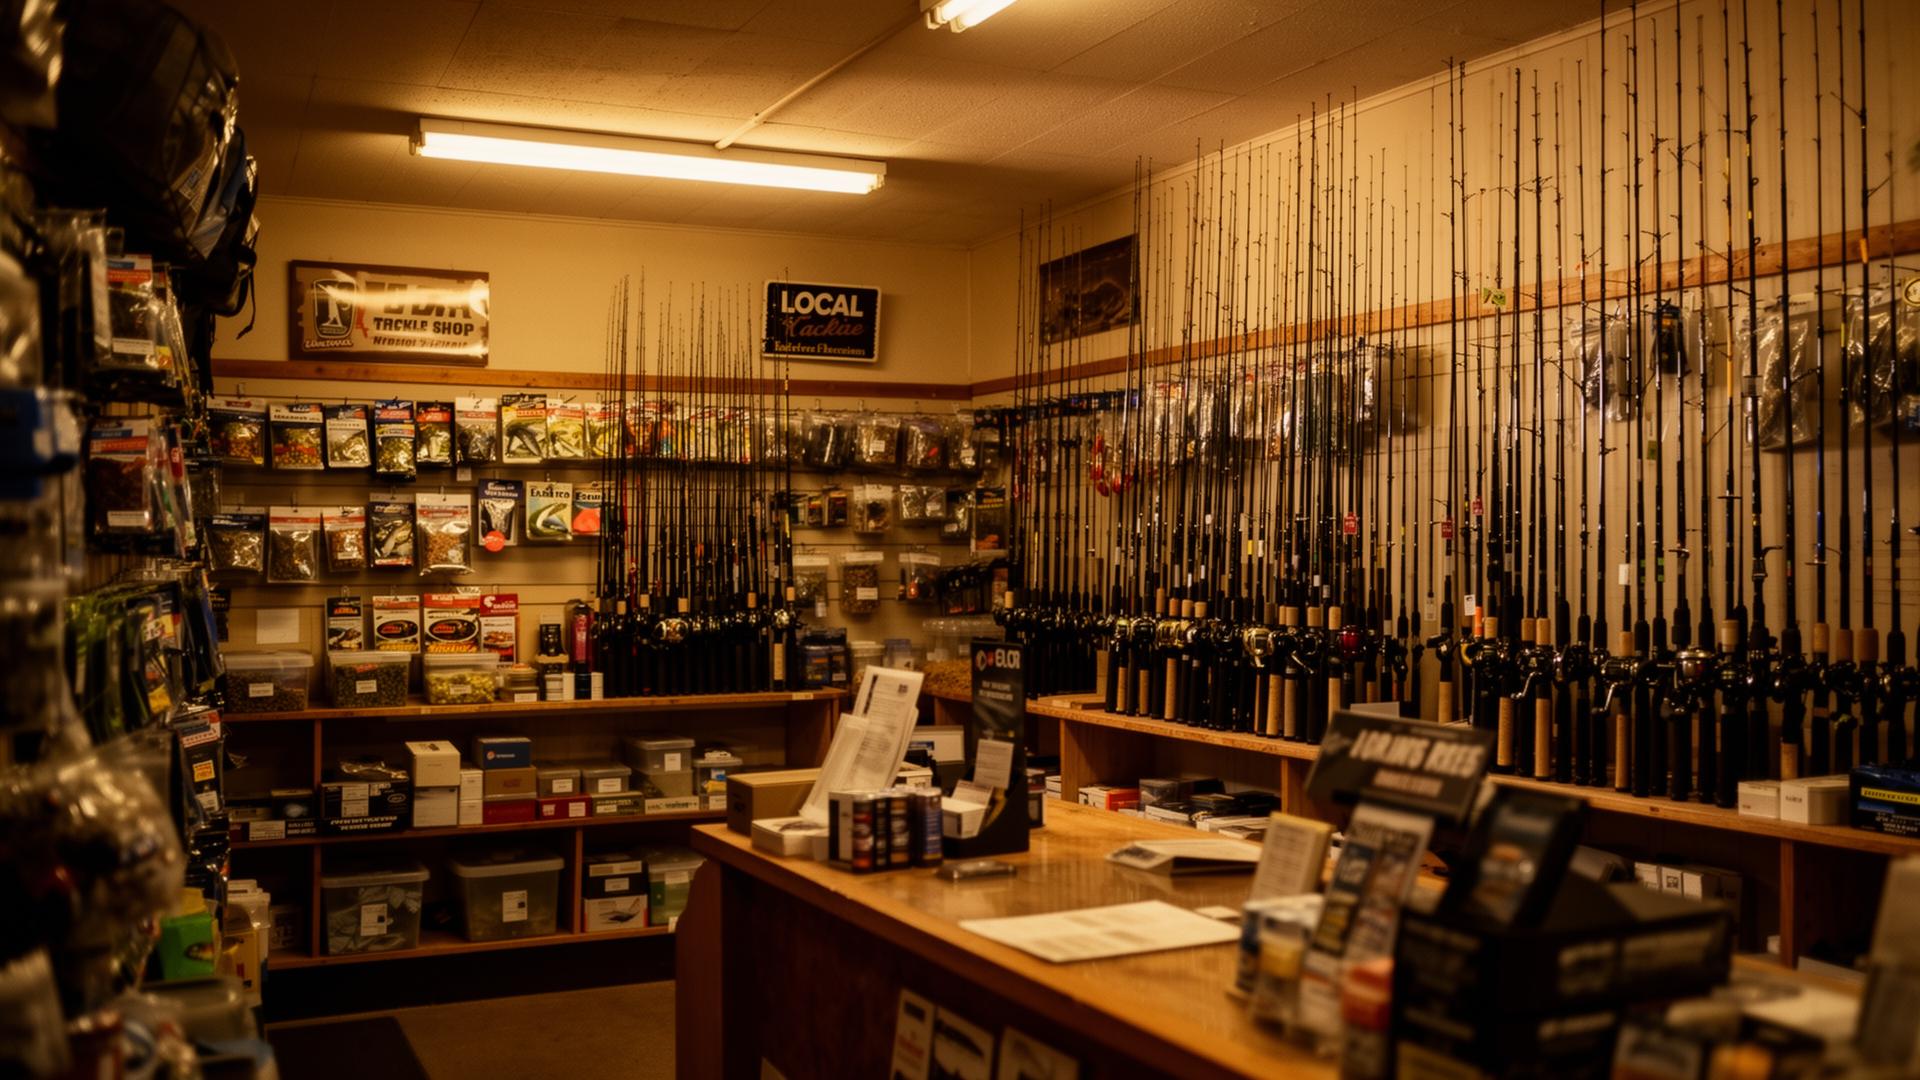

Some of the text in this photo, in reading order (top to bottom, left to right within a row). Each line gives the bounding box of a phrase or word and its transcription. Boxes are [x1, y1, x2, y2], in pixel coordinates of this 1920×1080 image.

[781, 290, 864, 318] LOCAL
[373, 316, 475, 337] TACKLE SHOP
